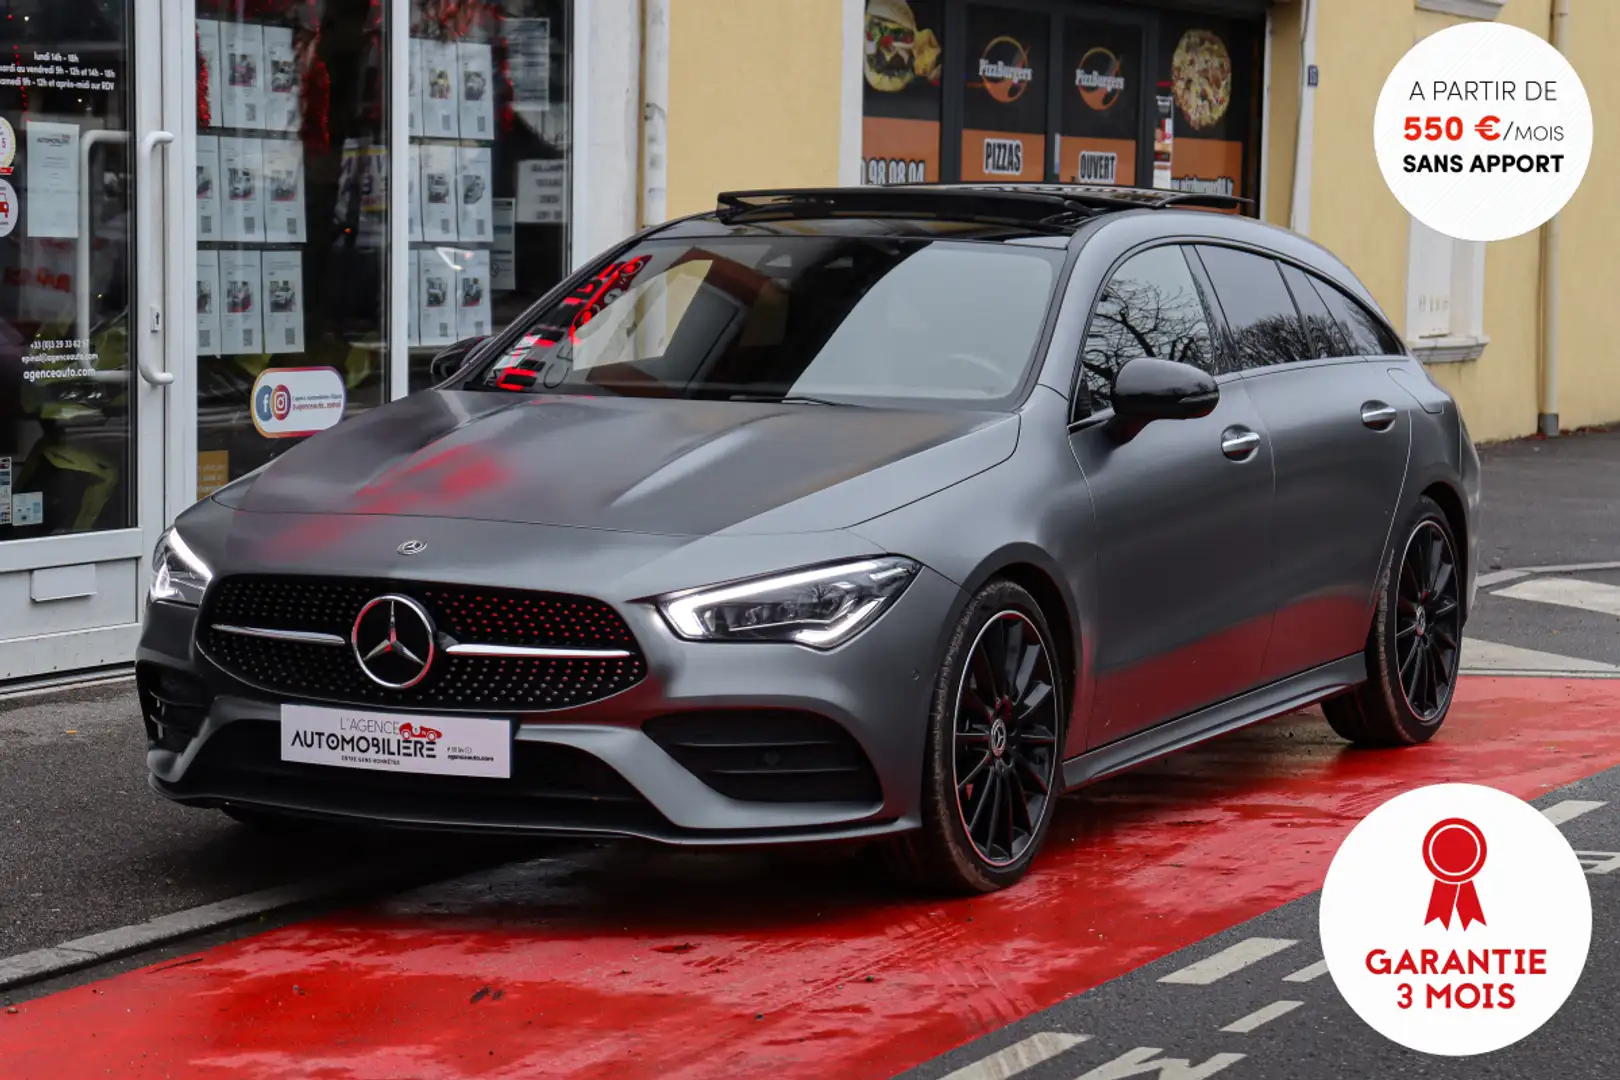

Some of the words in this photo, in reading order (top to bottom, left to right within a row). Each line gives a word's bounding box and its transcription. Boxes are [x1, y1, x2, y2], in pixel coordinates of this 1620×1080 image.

[26, 64, 55, 74] vendredi
[80, 67, 88, 76] et
[979, 58, 1033, 84] PizzBurgers
[1075, 68, 1125, 92] PizzBurgers
[90, 81, 101, 90] sur
[101, 80, 115, 91] RDV
[985, 142, 1022, 172] PIZZAS
[1080, 152, 1116, 180] OUVERT
[23, 366, 96, 382] agenceauto.com
[339, 716, 401, 736] L'AGENCE
